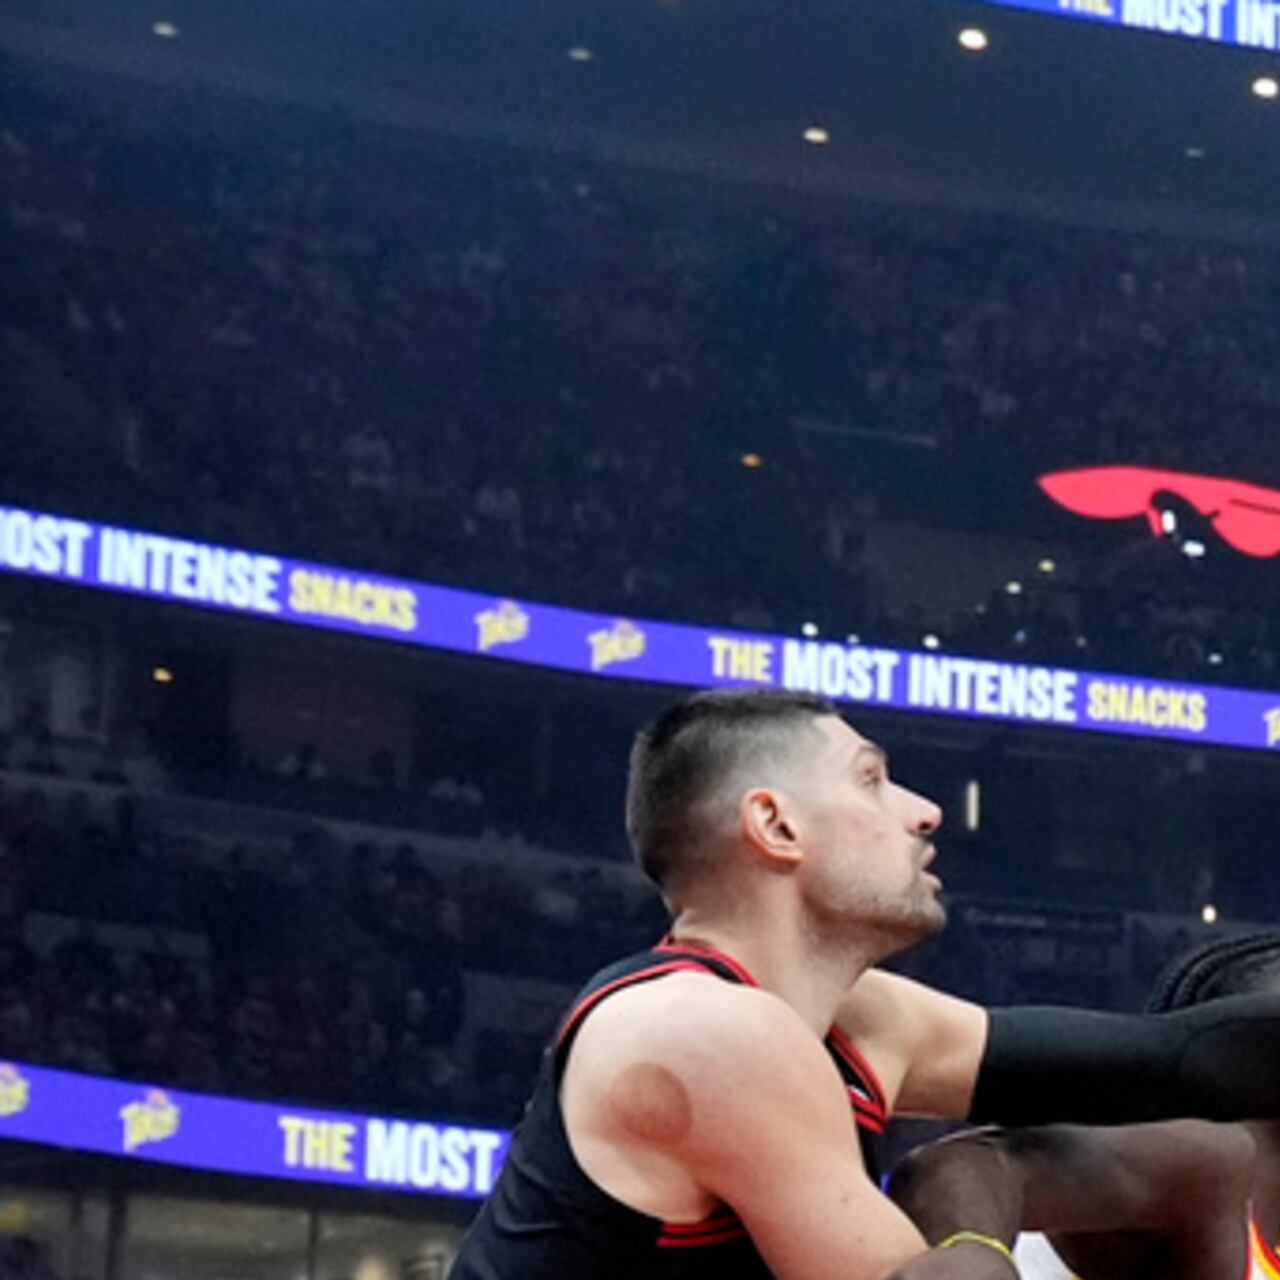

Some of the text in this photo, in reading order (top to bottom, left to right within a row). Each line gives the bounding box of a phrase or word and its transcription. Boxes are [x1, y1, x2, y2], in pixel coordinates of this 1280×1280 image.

[0, 508, 91, 577] OST
[99, 528, 281, 612] INTENSE
[289, 570, 416, 630] SNACKS
[709, 638, 1206, 731] THE MOST INTENSE SNACKS
[278, 1115, 499, 1193] THE MOST
